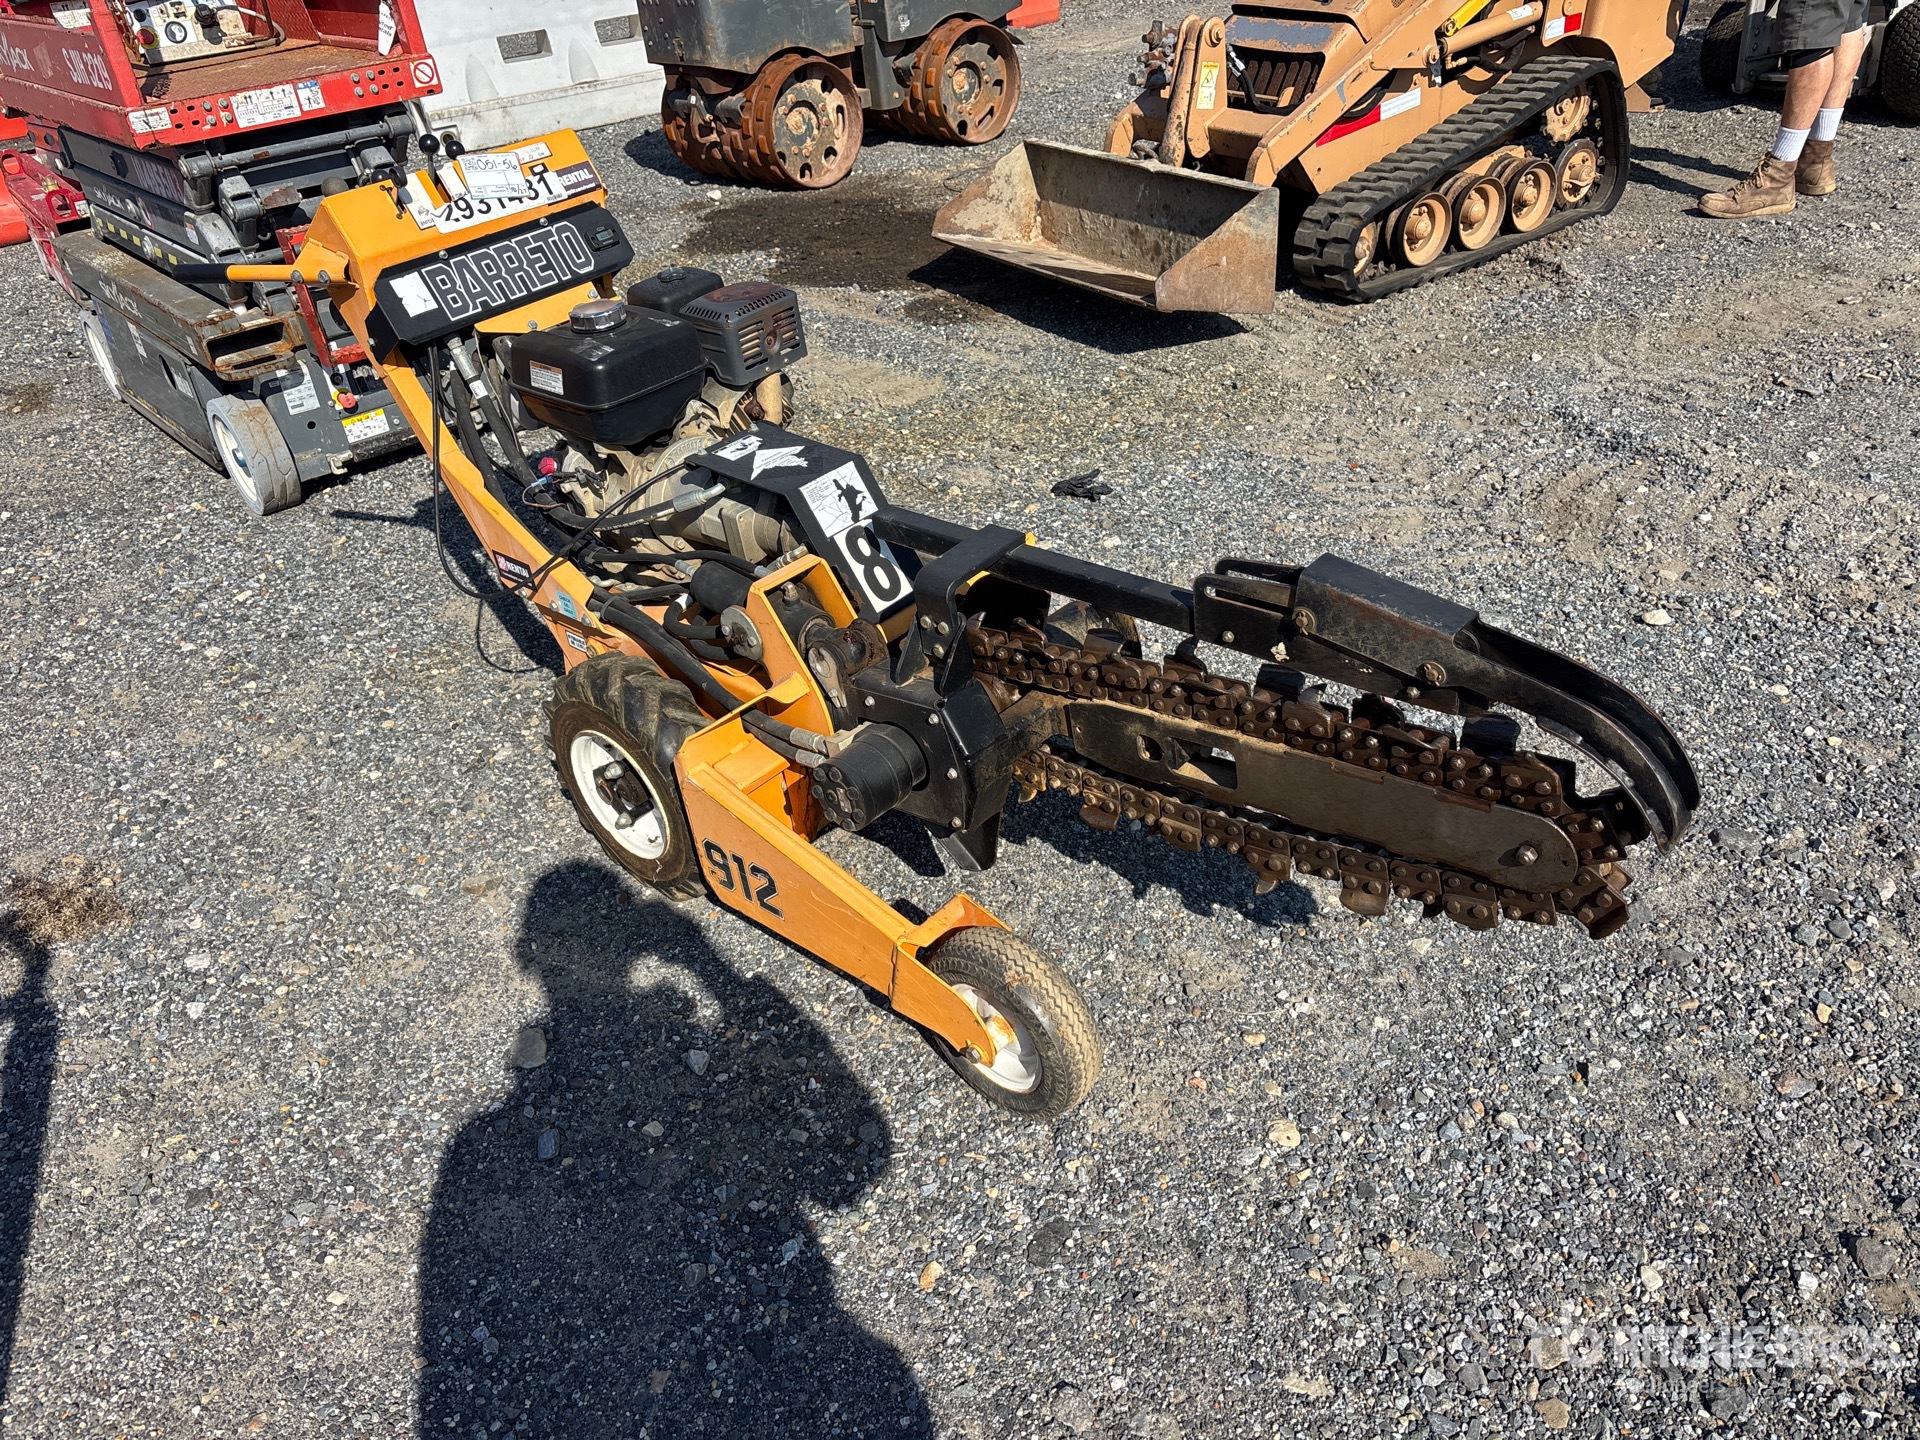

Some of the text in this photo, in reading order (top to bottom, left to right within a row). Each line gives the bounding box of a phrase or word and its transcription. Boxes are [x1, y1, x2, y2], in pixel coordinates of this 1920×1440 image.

[557, 168, 593, 187] RENTAL
[421, 221, 595, 321] BARRETO
[844, 524, 901, 602] 8
[702, 838, 785, 921] 912
